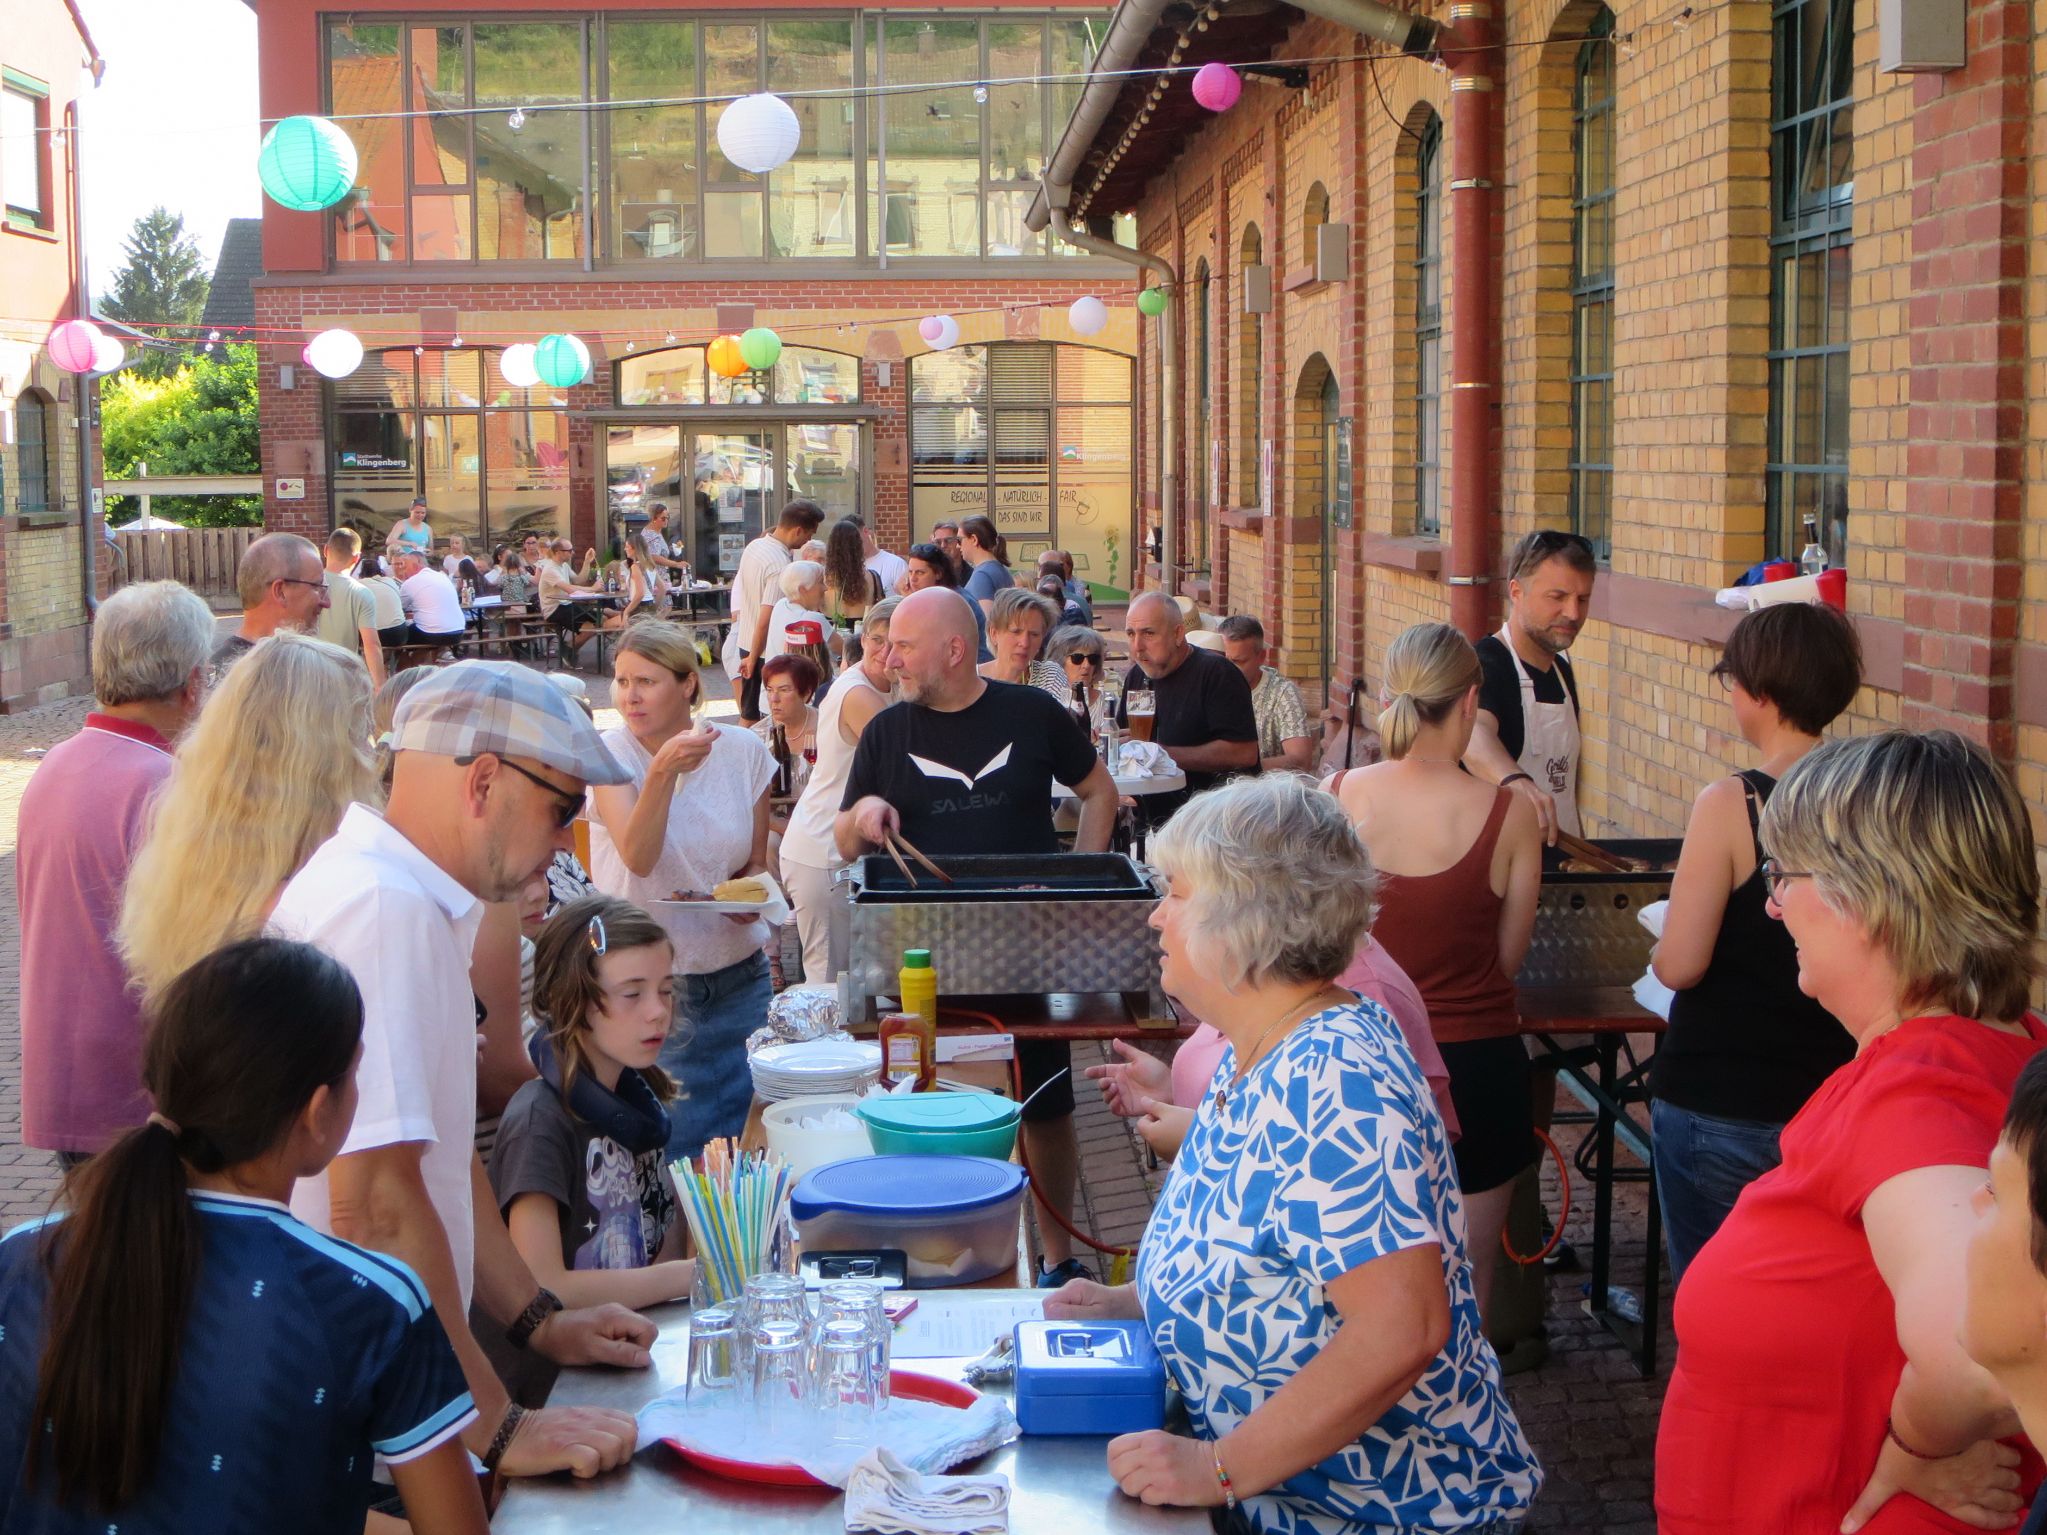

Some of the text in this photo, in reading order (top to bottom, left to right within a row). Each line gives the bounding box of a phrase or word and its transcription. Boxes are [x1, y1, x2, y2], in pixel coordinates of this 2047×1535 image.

[357, 459, 407, 467] Klingenberg
[950, 489, 1077, 503] REGIONAL NATÜRLICH FAIR
[998, 511, 1042, 522] DAS SIND WIR
